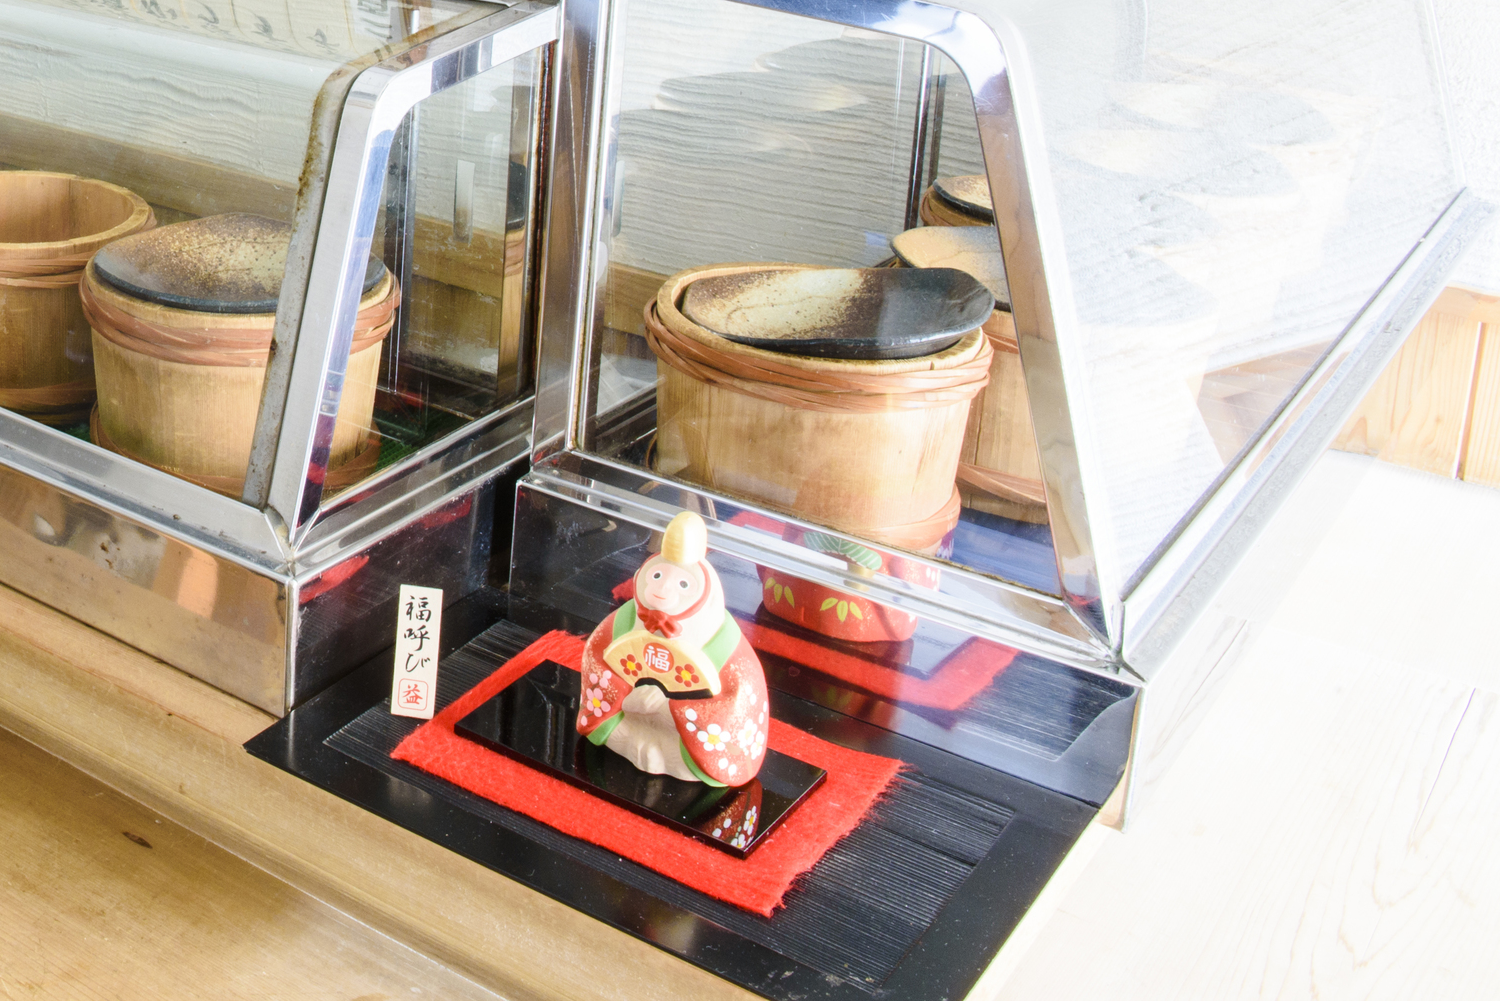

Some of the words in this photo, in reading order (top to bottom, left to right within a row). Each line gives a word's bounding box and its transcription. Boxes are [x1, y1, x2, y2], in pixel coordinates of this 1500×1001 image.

[404, 595, 431, 672] 福呼び
[645, 646, 670, 672] 福
